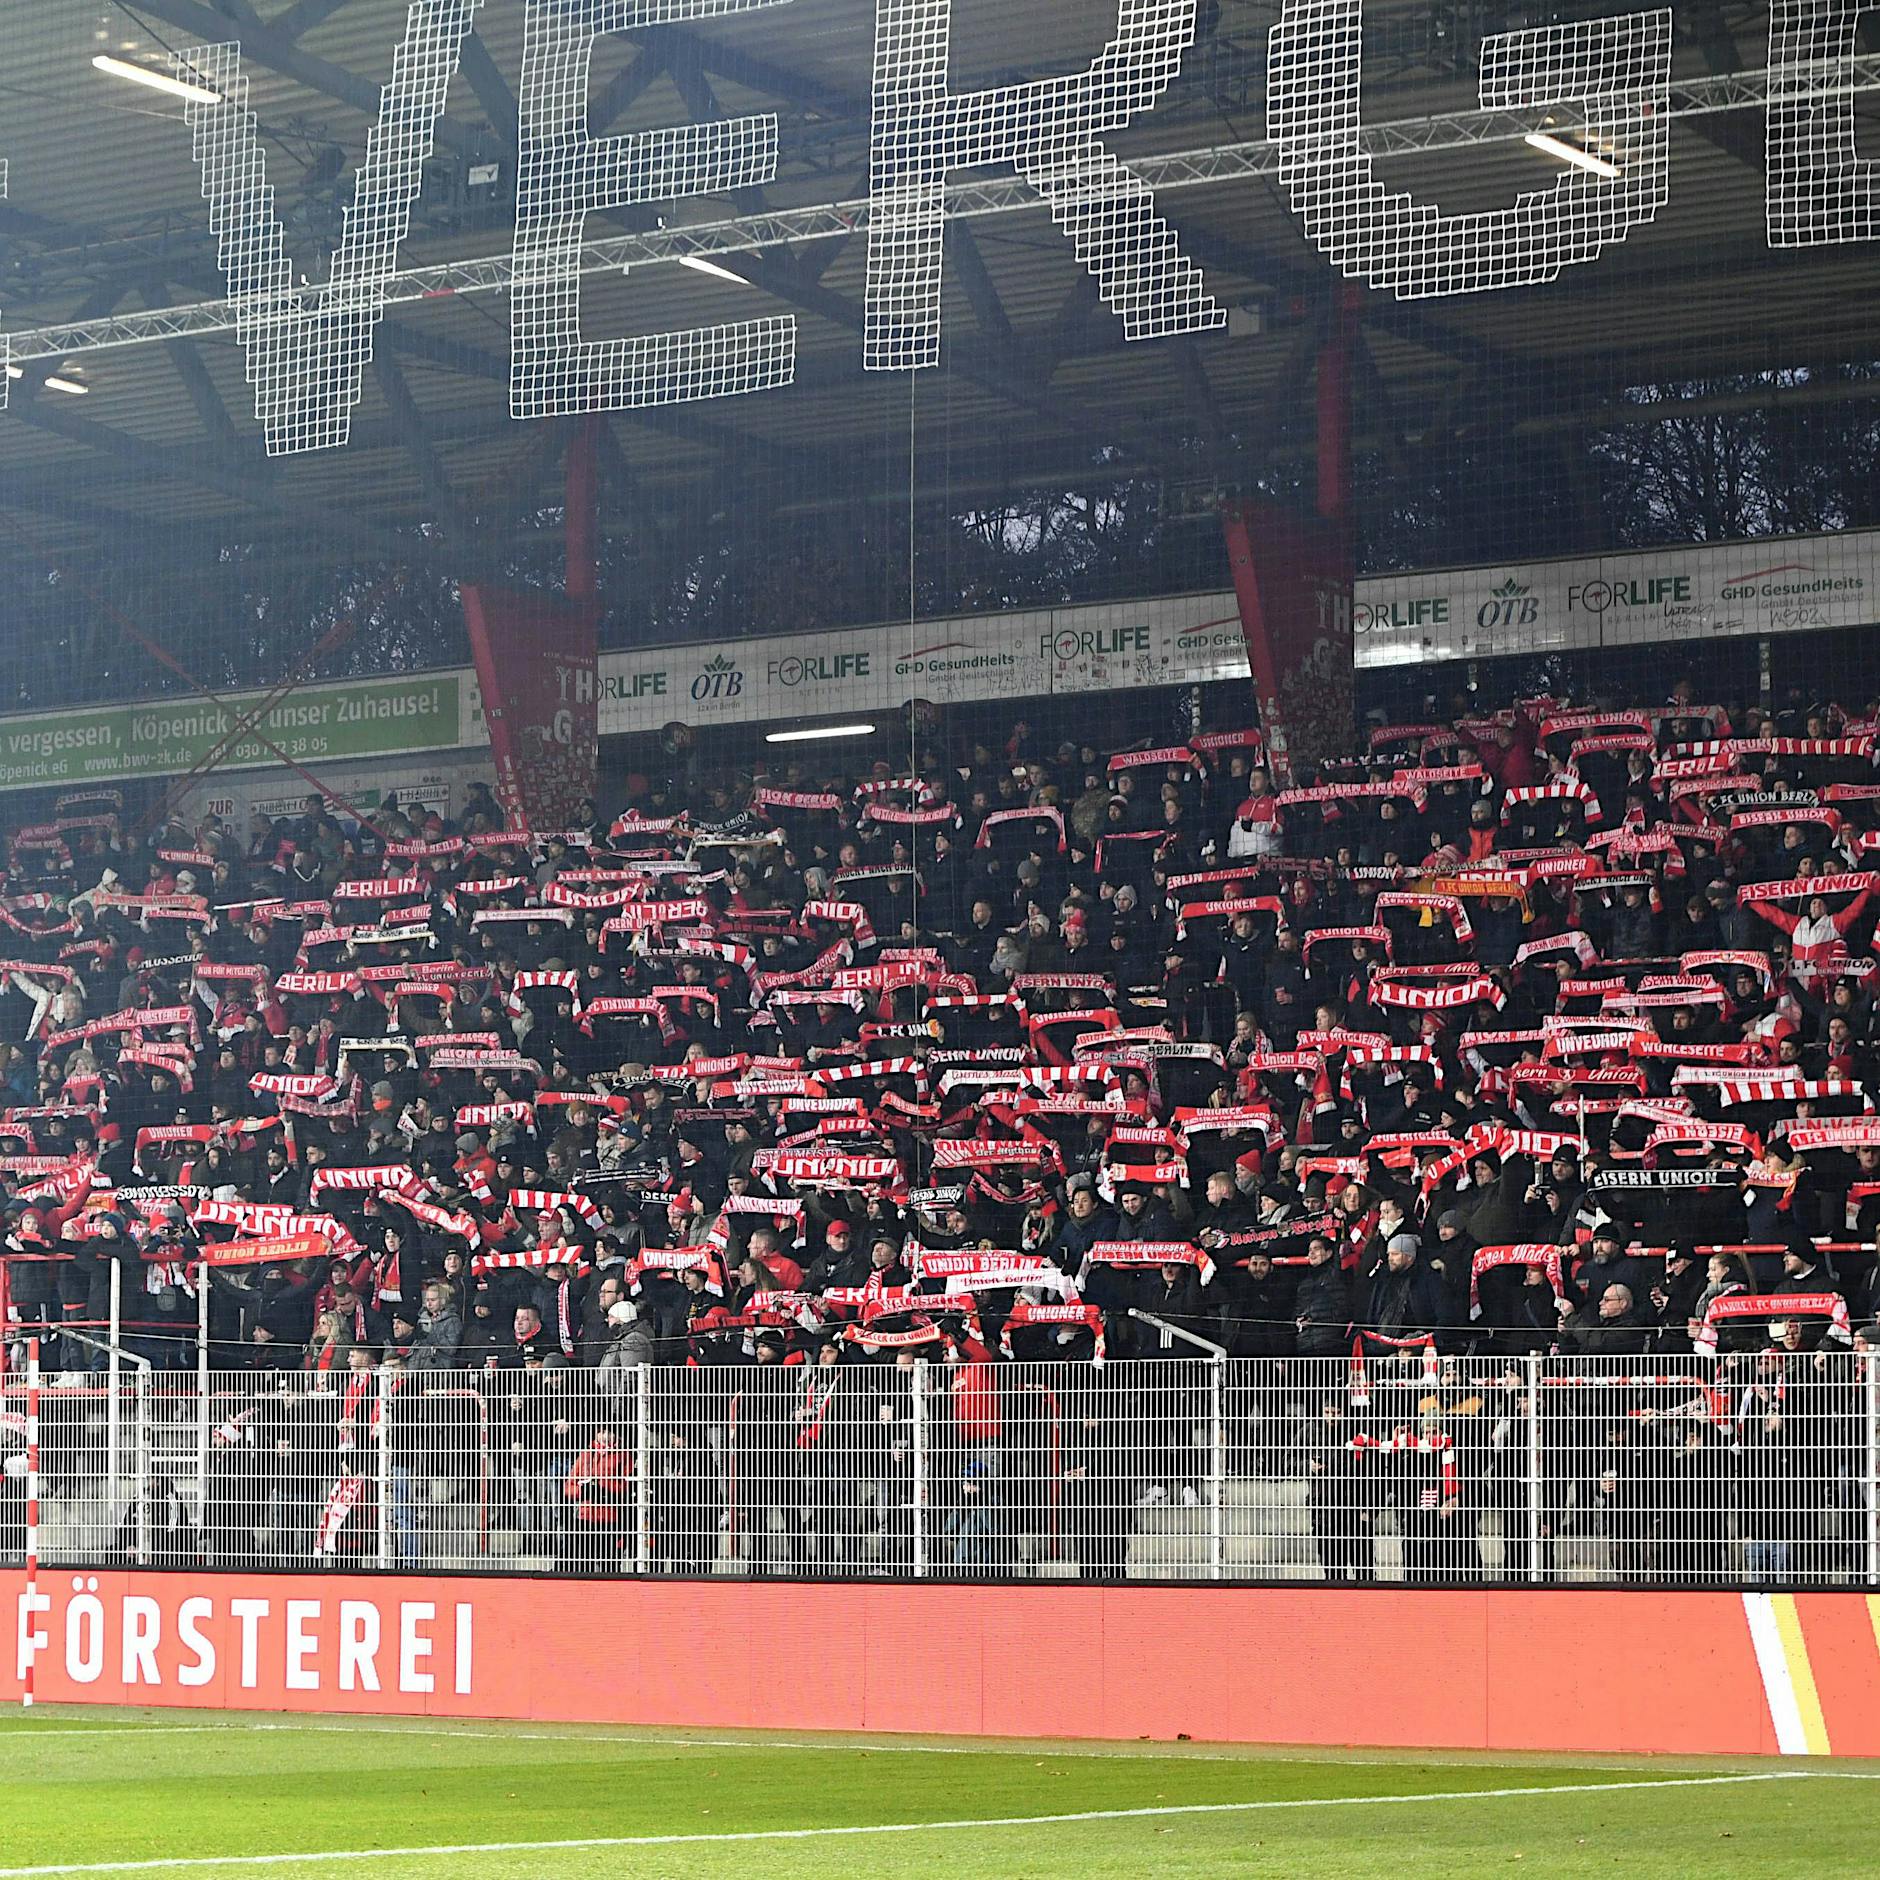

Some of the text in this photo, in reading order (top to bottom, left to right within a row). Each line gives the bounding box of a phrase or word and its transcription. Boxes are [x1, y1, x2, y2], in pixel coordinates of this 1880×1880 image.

[1568, 576, 1691, 612] FORLIFE
[1721, 577, 1863, 600] GHD GesundHeits
[1354, 598, 1449, 634] ORLIFE
[1477, 598, 1540, 628] OTB
[1040, 626, 1150, 661] FORLIFE
[1177, 635, 1208, 649] GHD
[767, 653, 870, 686] FORLIFE
[928, 654, 1015, 672] GesundHeits
[691, 671, 743, 700] OTB
[131, 706, 229, 747] Köpenick
[269, 704, 330, 730] unser
[336, 687, 440, 723] Zuhause!
[1551, 711, 1644, 729] EISERN UNION
[291, 737, 307, 754] 38
[311, 736, 328, 751] 05
[1200, 732, 1244, 748] UNIONER
[1122, 750, 1178, 763] WALDSEITE
[1404, 767, 1467, 780] WALDSEITE
[1720, 791, 1820, 808] FC UNION BERLIN
[208, 800, 234, 816] ZUR
[1786, 809, 1828, 820] UNION
[1669, 823, 1696, 833] Union
[1536, 858, 1587, 874] UNIONER
[558, 871, 582, 881] ALLES
[1740, 871, 1874, 899] EISERN UNION
[1206, 899, 1257, 912] UNIONER
[1322, 926, 1360, 937] Union
[1549, 935, 1571, 948] UNION
[371, 968, 386, 979] FC
[1817, 967, 1844, 975] BERLIN
[1377, 977, 1495, 1008] UNION
[1661, 995, 1684, 1003] UNION
[602, 998, 634, 1010] UNION
[889, 1026, 905, 1037] FC
[1309, 1031, 1328, 1043] FÜR
[975, 1047, 1026, 1062] UNION
[1641, 1041, 1725, 1058] WUHLESEITE
[694, 1056, 739, 1074] UNIONER
[1260, 1052, 1295, 1065] Union
[1588, 1067, 1638, 1081] Union
[1038, 1099, 1127, 1111] EISERN UNION
[150, 1126, 193, 1139] UNIONER
[1115, 1127, 1167, 1144] UNIONER
[1807, 1132, 1823, 1143] FC
[1825, 1130, 1864, 1142] UNION
[1593, 1169, 1718, 1187] EISERN UNION
[214, 1240, 310, 1260] UNION BERLIN
[927, 1256, 1041, 1274] UNION BERLIN
[881, 1295, 960, 1311] WALDSEITE
[1719, 1300, 1748, 1314] JAHRE
[1757, 1299, 1769, 1311] FC
[1027, 1306, 1086, 1321] UNIONER
[17, 1575, 473, 1695] FÖRSTEREI
